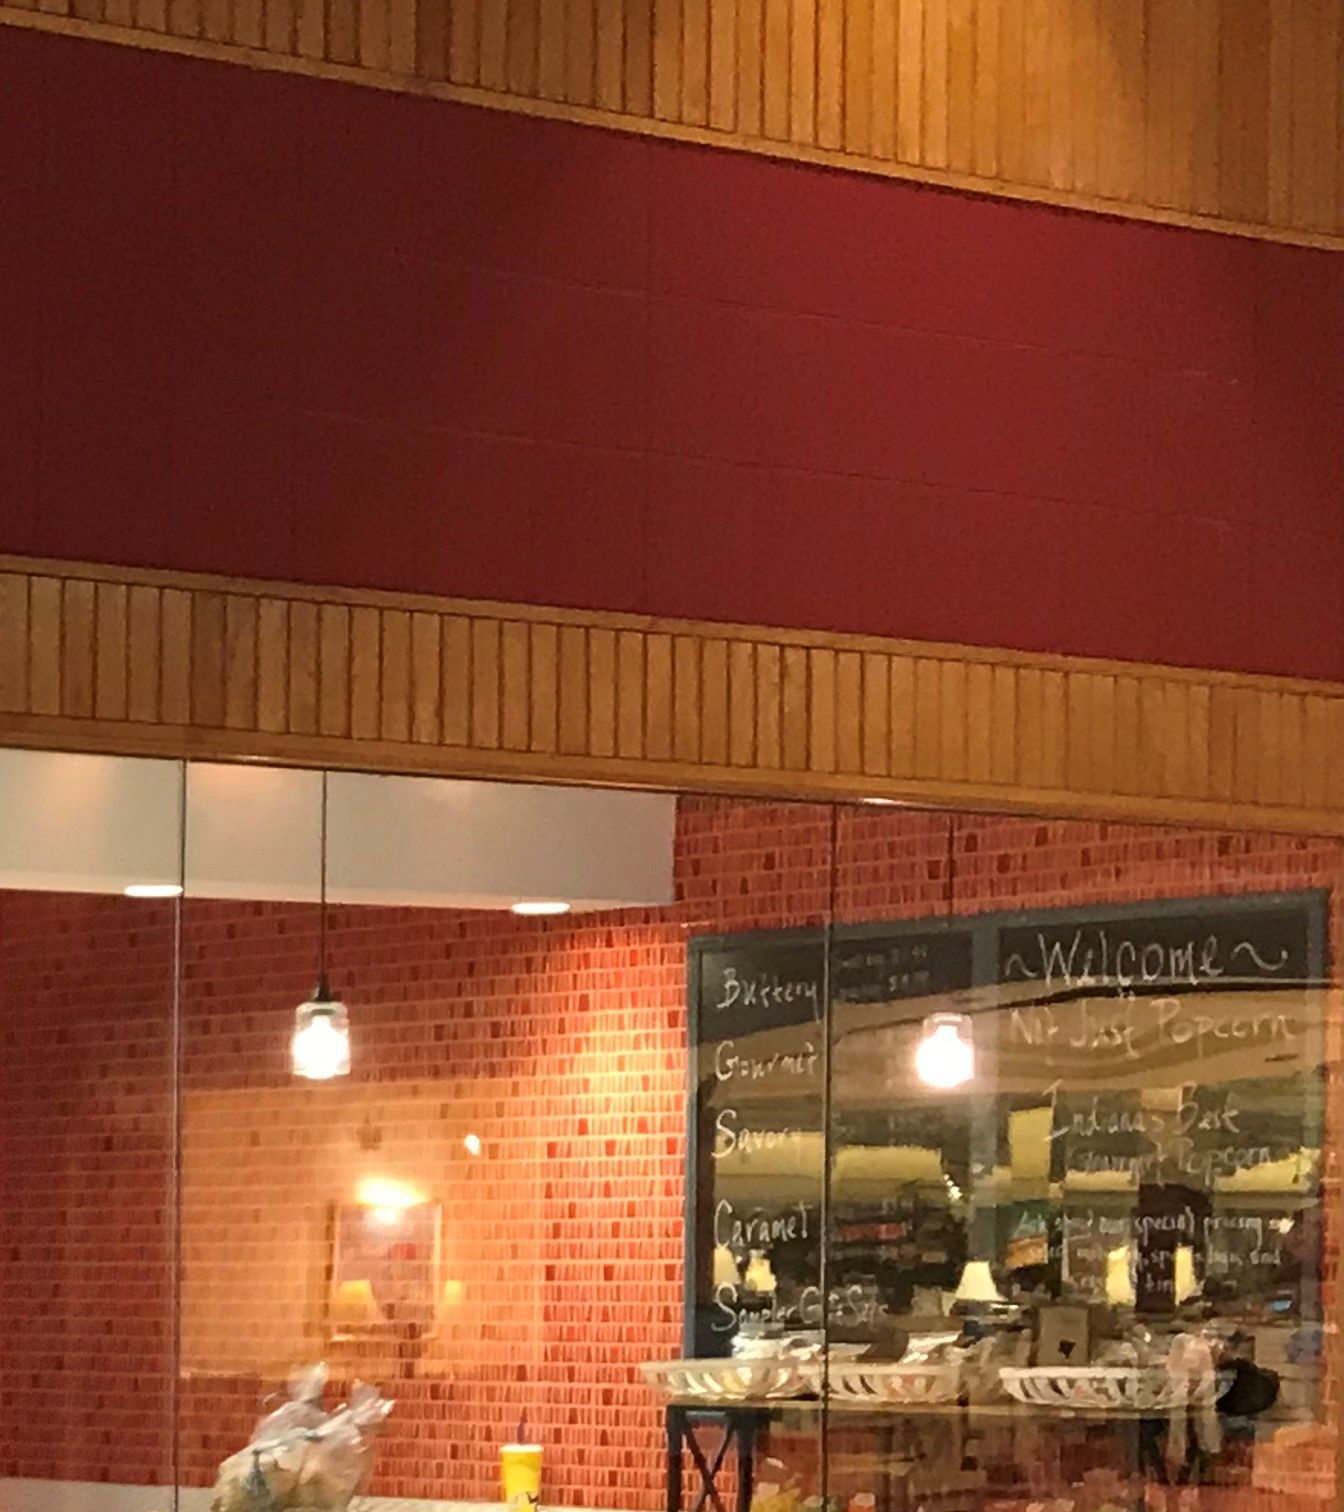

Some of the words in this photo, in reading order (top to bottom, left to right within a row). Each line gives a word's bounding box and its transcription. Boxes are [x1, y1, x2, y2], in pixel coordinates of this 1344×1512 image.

[717, 968, 822, 1024] Buttery
[715, 1040, 819, 1081] Gourmet
[714, 1199, 808, 1247] Caramel
